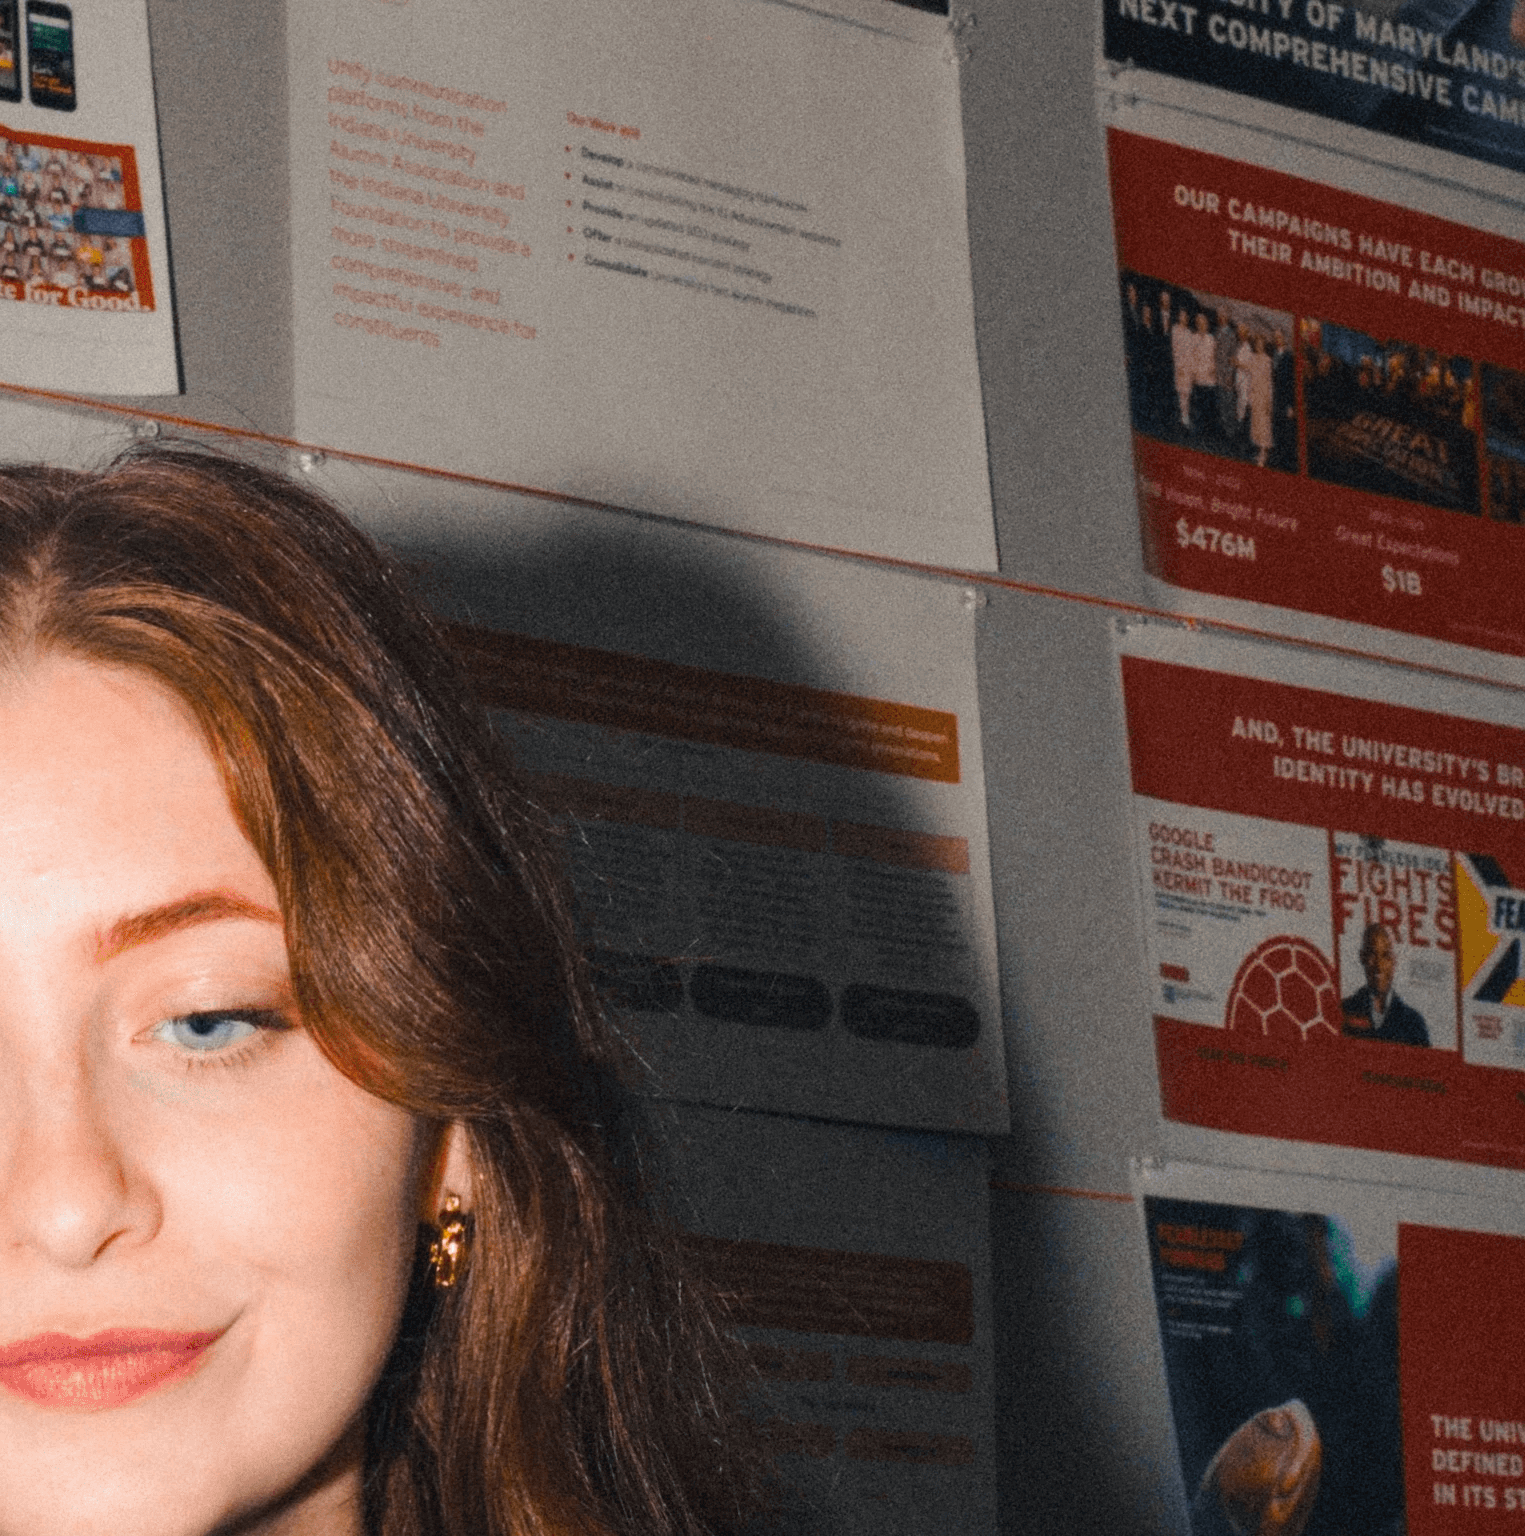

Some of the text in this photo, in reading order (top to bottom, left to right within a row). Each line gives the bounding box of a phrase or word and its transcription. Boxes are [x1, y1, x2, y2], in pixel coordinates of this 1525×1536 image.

[1306, 0, 1344, 32] OF
[1120, 0, 1198, 36] NEXT
[1209, 14, 1453, 108] COMPREHENSIVE
[327, 58, 508, 113] Unify communication
[327, 85, 485, 138] platforms from the
[327, 111, 476, 168] Indiana University
[330, 139, 525, 201] Alumni Association and
[329, 167, 511, 230] the Indiana University
[331, 199, 427, 231] Foundation
[429, 219, 451, 240] to
[453, 227, 519, 257] provide
[331, 225, 376, 249] more
[1175, 183, 1219, 214] OUR
[1228, 198, 1353, 251] CAMPAIGNS
[1358, 235, 1413, 268] HAVE
[1420, 250, 1475, 283] EACH
[1228, 228, 1292, 264] THEIR
[1300, 251, 1401, 295] AMBITION
[1408, 280, 1451, 308] AND
[332, 281, 537, 340] impactful experience for
[470, 284, 501, 306] and
[1176, 516, 1257, 562] $476M
[1334, 523, 1461, 566] Great Expectations
[1381, 562, 1424, 597] $1B
[1231, 715, 1284, 747] AND,
[1292, 725, 1334, 755] THE
[1341, 734, 1491, 783] UNIVERSITY'S
[1273, 755, 1374, 794] IDENTITY
[1381, 774, 1425, 804] HAS
[1149, 822, 1215, 853] GOOGLE
[1150, 845, 1313, 892] CRASH BANDICOOT
[1152, 867, 1212, 897] KERMIT
[1219, 876, 1253, 904] THE
[1260, 886, 1307, 914] FROG
[1334, 858, 1455, 907] FIGHTS
[1334, 893, 1456, 953] FIRES
[1431, 1413, 1473, 1441] THE
[1432, 1447, 1524, 1477] DEFINED
[1433, 1482, 1456, 1506] IN
[1462, 1484, 1497, 1509] ITS
